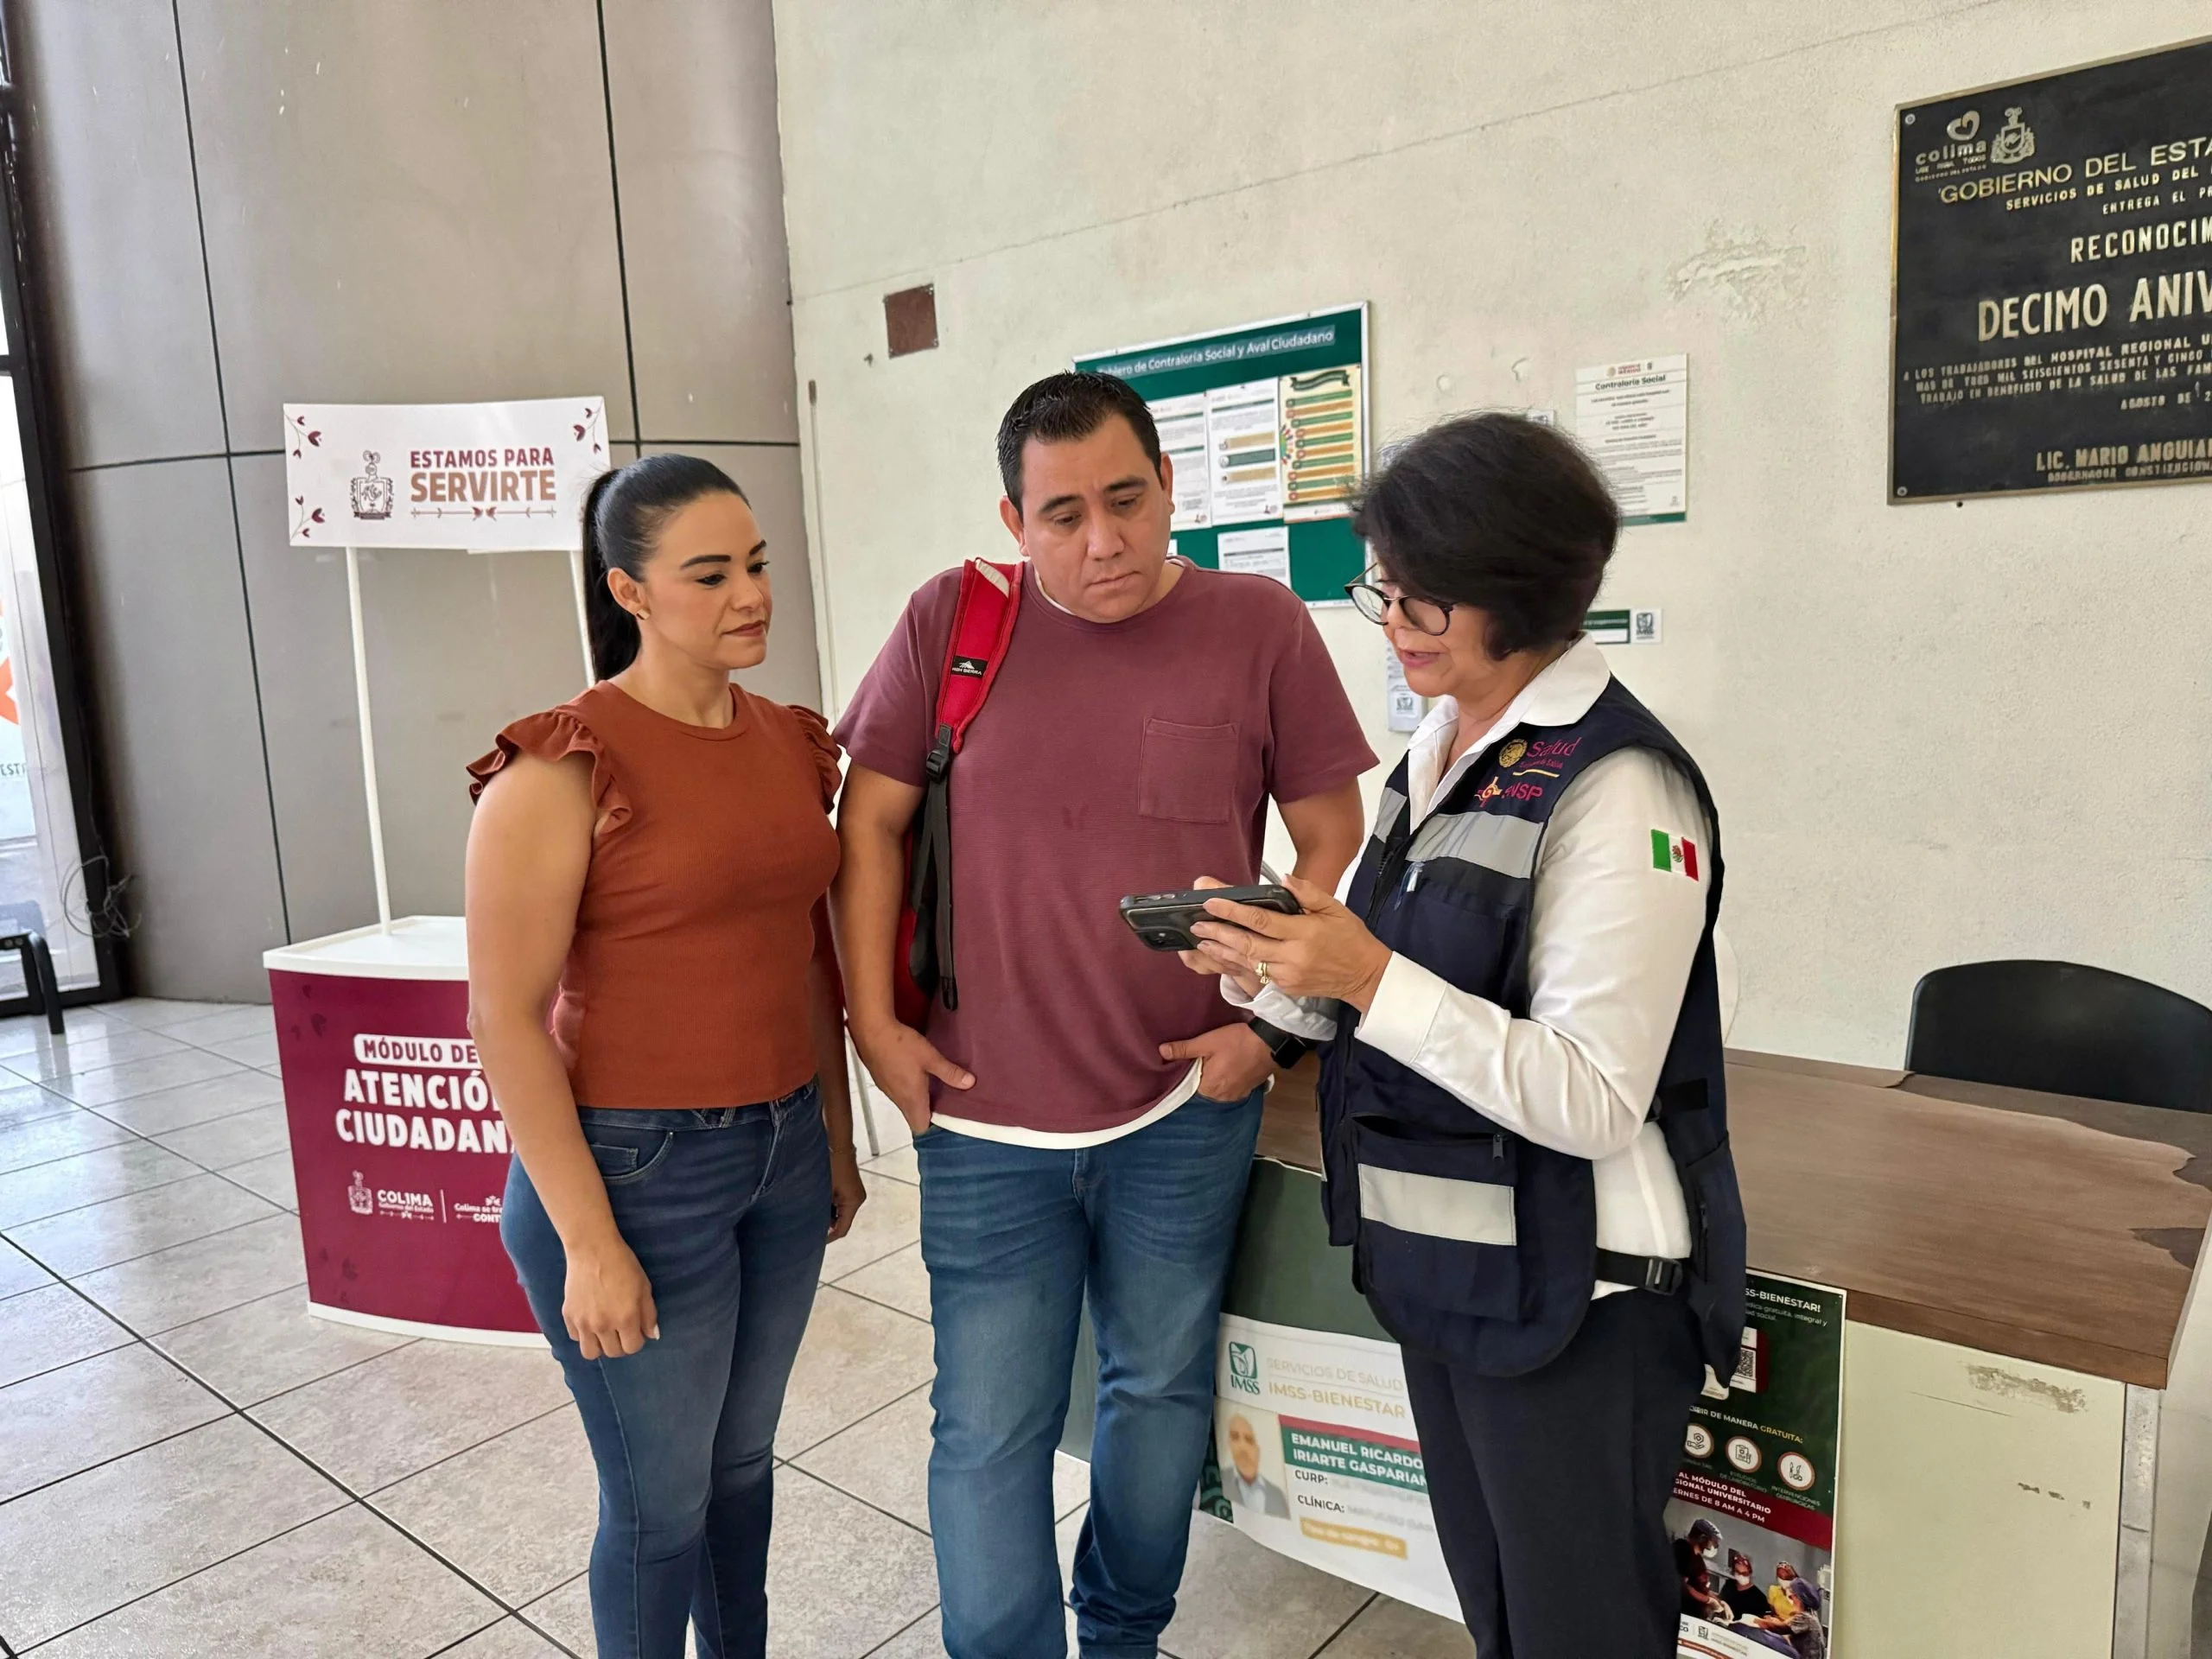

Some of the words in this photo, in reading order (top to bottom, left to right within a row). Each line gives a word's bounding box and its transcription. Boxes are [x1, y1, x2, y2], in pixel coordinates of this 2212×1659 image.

[1916, 140, 1986, 165] colima
[1941, 164, 2072, 203] GOBIERNO
[2085, 152, 2137, 178] DEL
[2005, 188, 2076, 211] SERVICIOS
[2087, 182, 2104, 197] DE
[2114, 173, 2160, 192] SALUD
[2172, 165, 2199, 181] DEL
[2102, 195, 2160, 215] ENTREGA
[2172, 191, 2186, 203] EL
[1978, 283, 2108, 342] DECIMO
[1135, 362, 1147, 372] de
[1205, 345, 1236, 361] Social
[1238, 347, 1244, 359] y
[1247, 339, 1269, 355] Aval
[1271, 331, 1333, 350] Ciudadano
[1915, 367, 1935, 380] LOS
[1941, 357, 2018, 376] TRABAJADORES
[2024, 354, 2043, 366] DEL
[2050, 346, 2113, 363] HOSPITAL
[2121, 336, 2191, 356] REGIONAL
[1642, 374, 1666, 385] Social
[1998, 372, 2016, 383] MIL
[2022, 362, 2091, 380] SEISCIENTOS
[2100, 355, 2149, 372] SESENTA
[2154, 355, 2161, 365] Y
[2168, 349, 2203, 364] CINCO
[1920, 390, 1963, 404] TRABAJO
[1969, 388, 1981, 399] EN
[1987, 380, 2042, 397] BENEFICIO
[2049, 378, 2062, 391] DE
[2069, 377, 2082, 388] LA
[2090, 372, 2126, 386] SALUD
[2134, 370, 2147, 381] DE
[2156, 366, 2177, 379] LAS
[2120, 395, 2166, 410] AGOSTO
[2177, 392, 2191, 404] DE
[410, 448, 498, 469] ESTAMOS
[505, 447, 554, 467] PARA
[2036, 450, 2070, 472] LIC.
[2075, 445, 2129, 467] MARIO
[410, 469, 556, 503] SERVIRTE
[1527, 737, 1582, 758] Salud
[363, 1037, 442, 1063] MÓDULO
[452, 1045, 477, 1064] DE
[344, 1069, 500, 1112] ATENCIÓ
[335, 1109, 516, 1154] CIUDADAN
[378, 1190, 433, 1207] COLIMA
[454, 1203, 480, 1212] Colima
[1230, 1374, 1261, 1395] IMSS
[1266, 1357, 1333, 1379] SERVICIOS
[1336, 1367, 1357, 1382] DE
[1358, 1371, 1405, 1392] SALUD
[1268, 1382, 1407, 1420] IMSS-BIENESTAR
[1710, 1410, 1722, 1420] DE
[1723, 1414, 1759, 1430] MANERA
[1760, 1425, 1804, 1444] GRATUITA:
[1291, 1433, 1357, 1456] EMANUEL
[1361, 1446, 1424, 1469] RICARDO
[1293, 1448, 1345, 1469] IRIARTE
[1295, 1470, 1328, 1484] CURP:
[1678, 1471, 1689, 1480] AL
[1692, 1473, 1728, 1491] MÓDULO
[1730, 1486, 1746, 1497] DEL
[1298, 1494, 1344, 1513] CLÍNICA:
[1701, 1496, 1713, 1504] DE
[1714, 1498, 1720, 1507] 8
[1722, 1502, 1735, 1512] AM
[1745, 1509, 1751, 1517] 4
[1751, 1513, 1765, 1523] PM
[1707, 1487, 1771, 1515] UNIVERSITARIO
